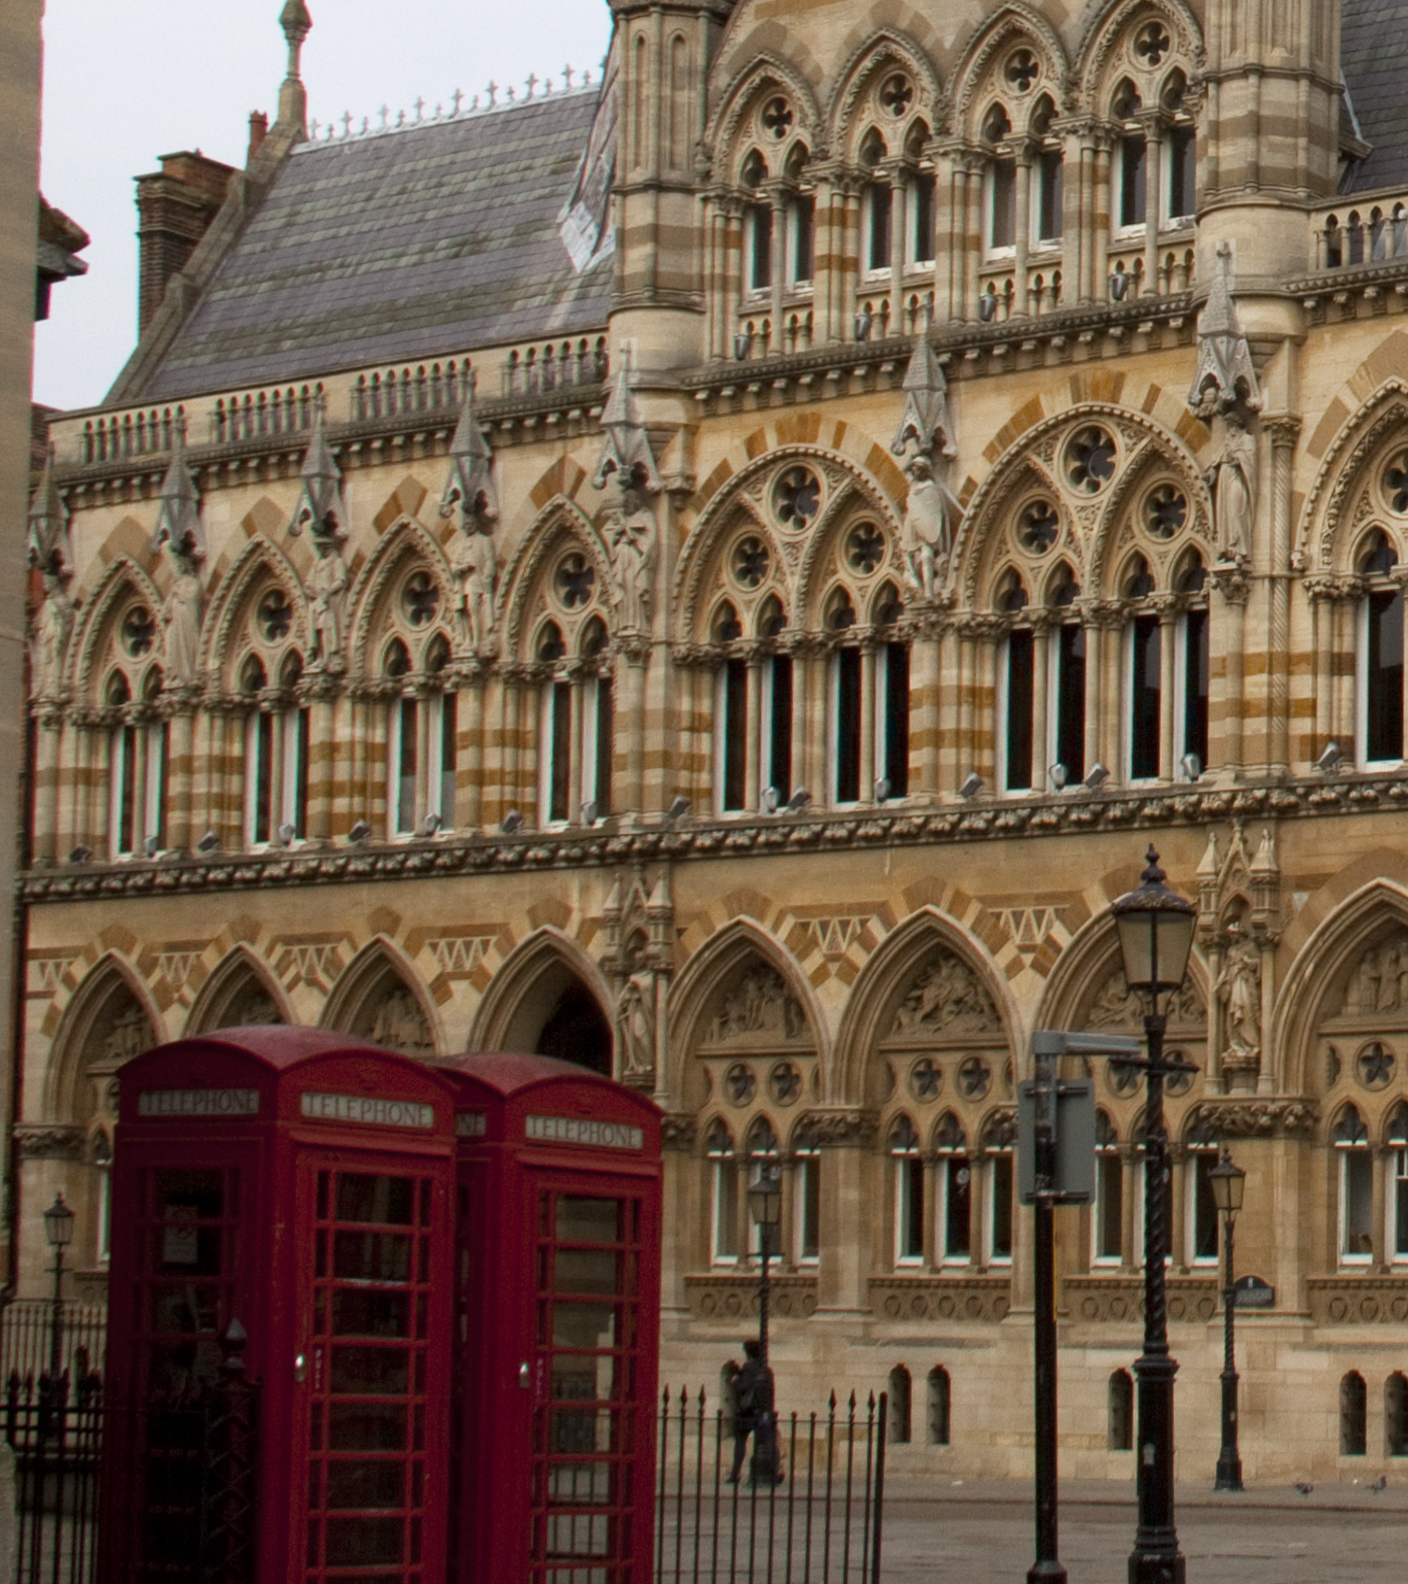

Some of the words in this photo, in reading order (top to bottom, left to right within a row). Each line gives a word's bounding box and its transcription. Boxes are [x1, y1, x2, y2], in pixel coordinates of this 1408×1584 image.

[147, 1090, 257, 1114] TELEPHONE
[307, 1093, 429, 1126] TELEPHONE
[530, 1116, 640, 1147] TELEPHONE
